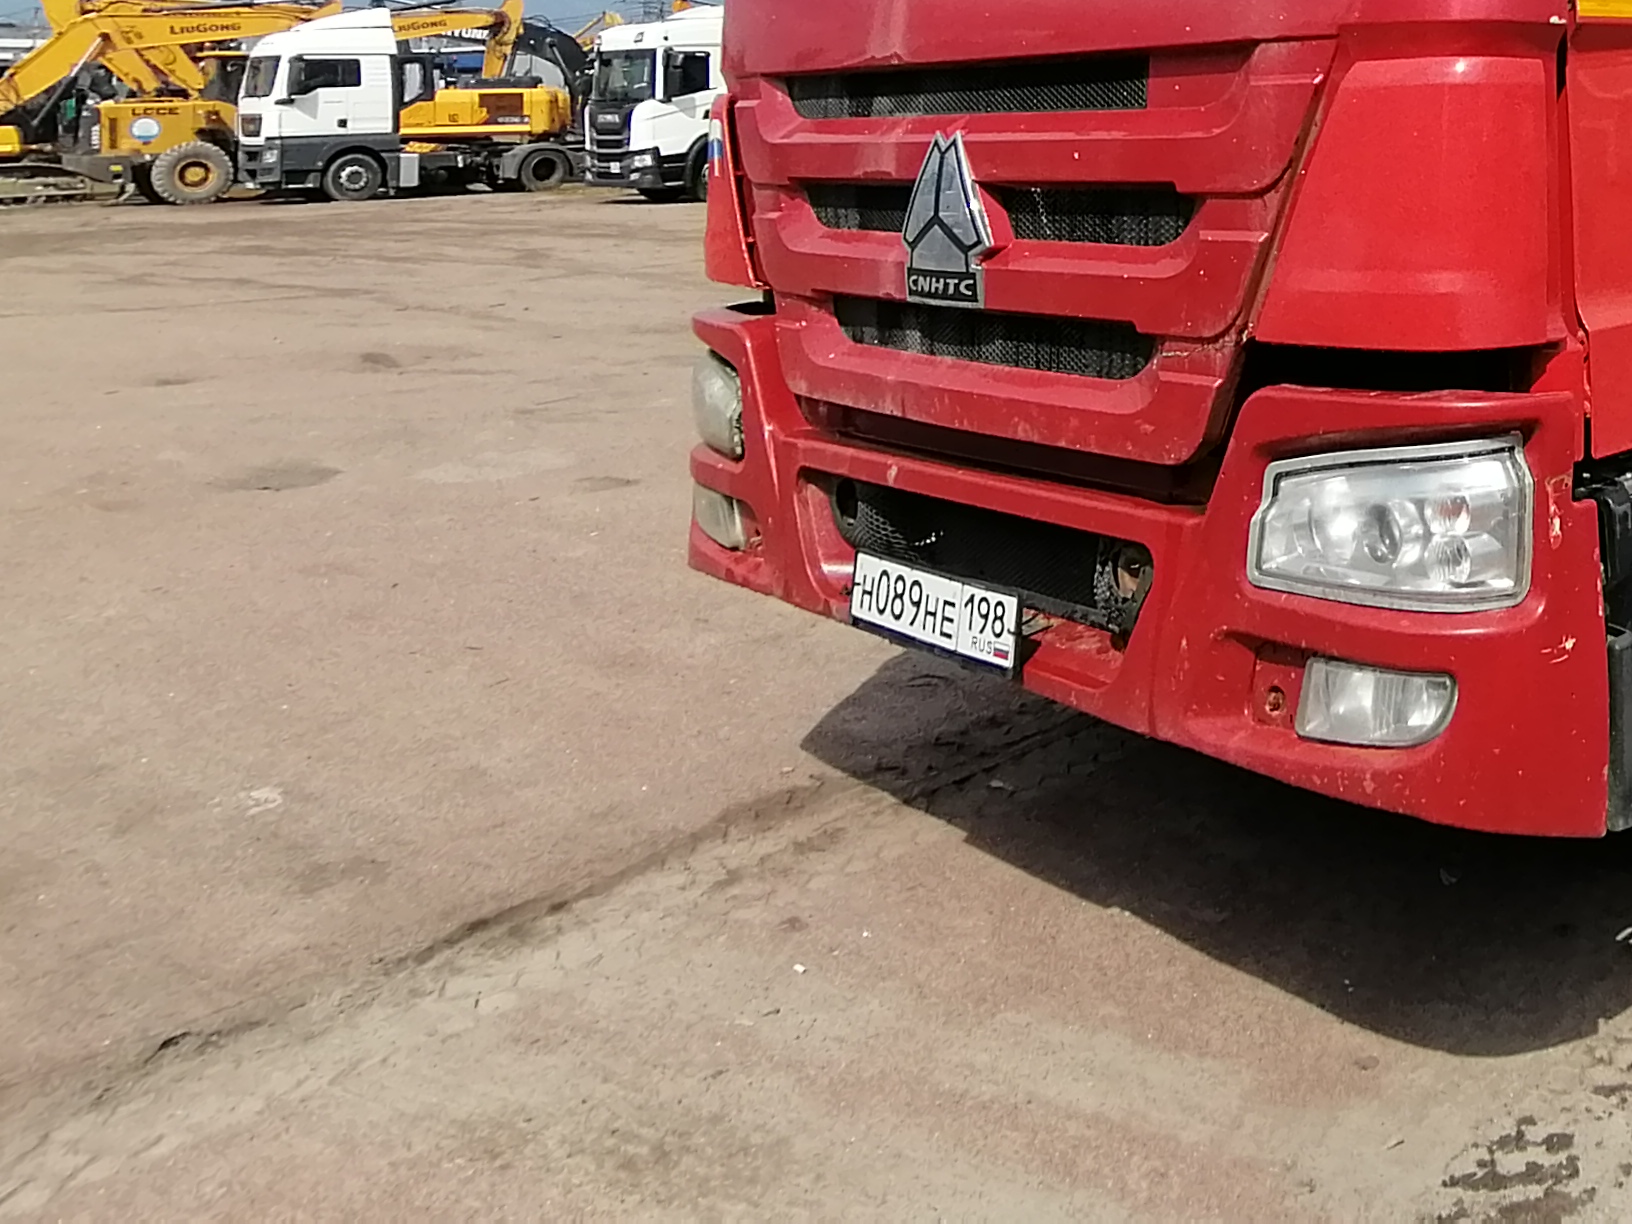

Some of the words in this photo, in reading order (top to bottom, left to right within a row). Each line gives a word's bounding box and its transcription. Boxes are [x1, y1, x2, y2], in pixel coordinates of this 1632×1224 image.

[909, 274, 974, 296] CNHTC
[964, 593, 1006, 639] 198
[971, 636, 993, 655] RUS
